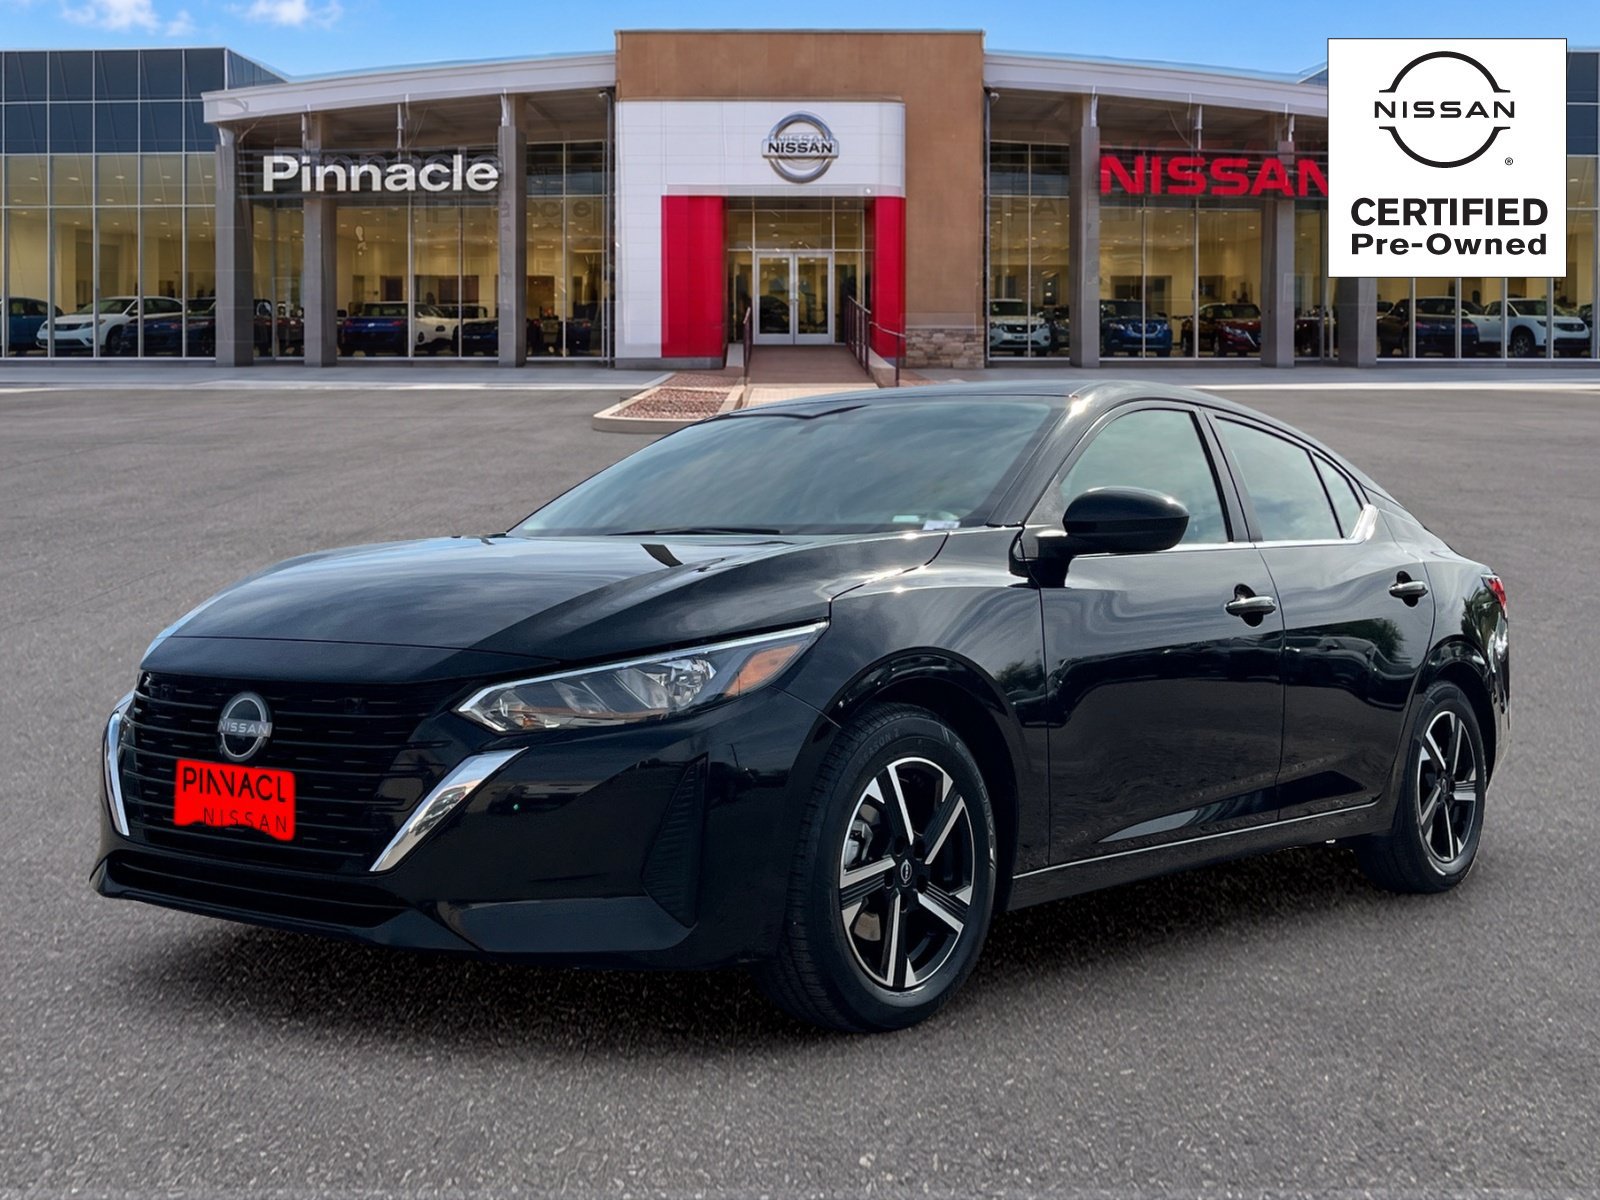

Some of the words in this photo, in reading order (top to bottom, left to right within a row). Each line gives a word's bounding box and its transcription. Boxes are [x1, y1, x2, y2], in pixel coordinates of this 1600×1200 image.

[768, 142, 833, 154] NISSAN
[263, 154, 498, 192] Pinnacle
[219, 720, 268, 735] NISSAN
[203, 807, 287, 833] NISSAN
